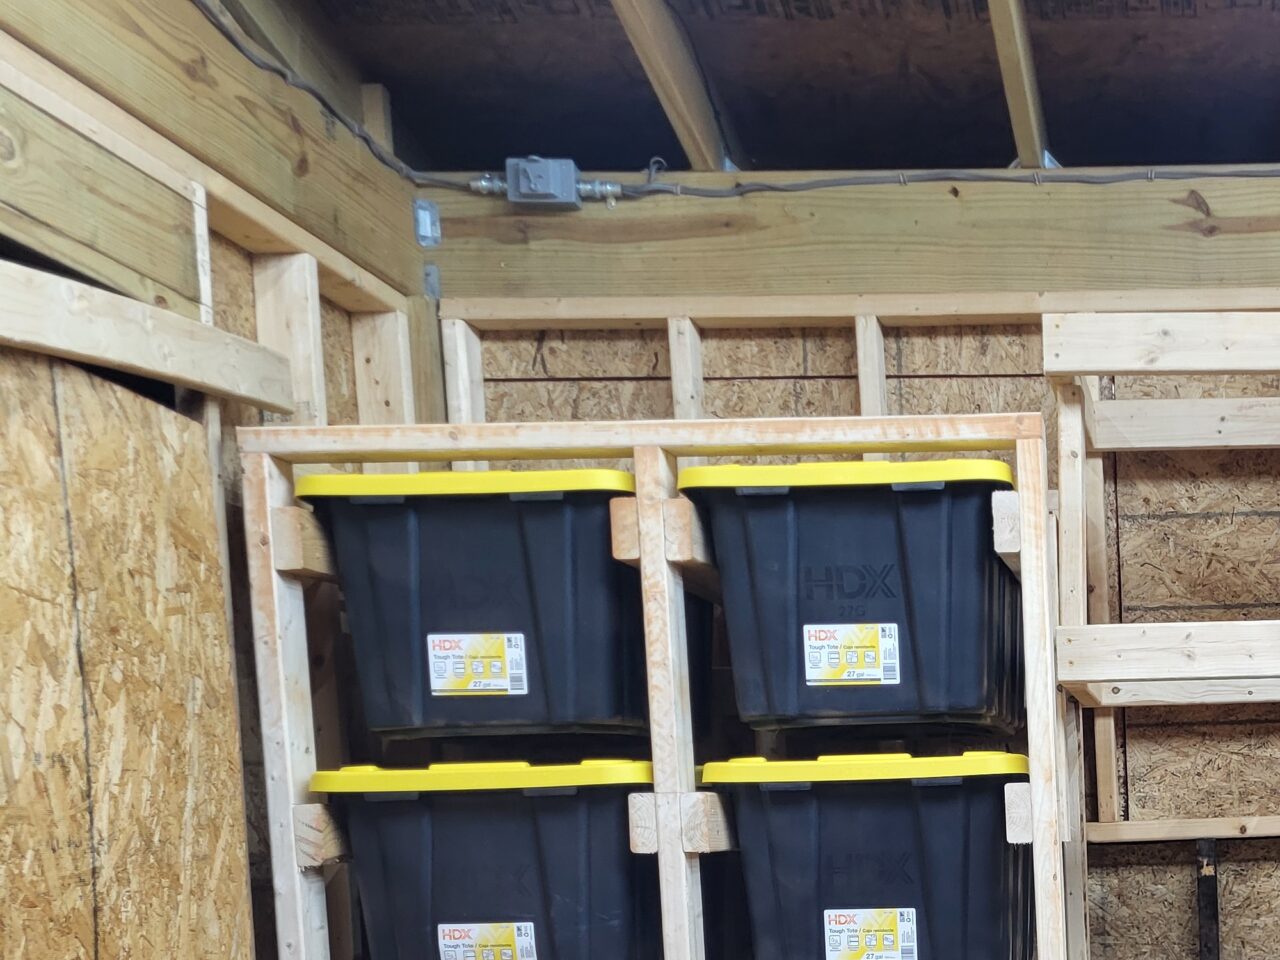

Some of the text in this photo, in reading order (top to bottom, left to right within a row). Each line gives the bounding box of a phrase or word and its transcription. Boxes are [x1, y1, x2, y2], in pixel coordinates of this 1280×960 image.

[804, 564, 897, 599] HDX
[840, 604, 866, 617] 27G
[808, 629, 838, 641] HDX
[432, 639, 463, 651] HDX
[828, 914, 857, 925] HDX
[442, 928, 473, 940] HDX
